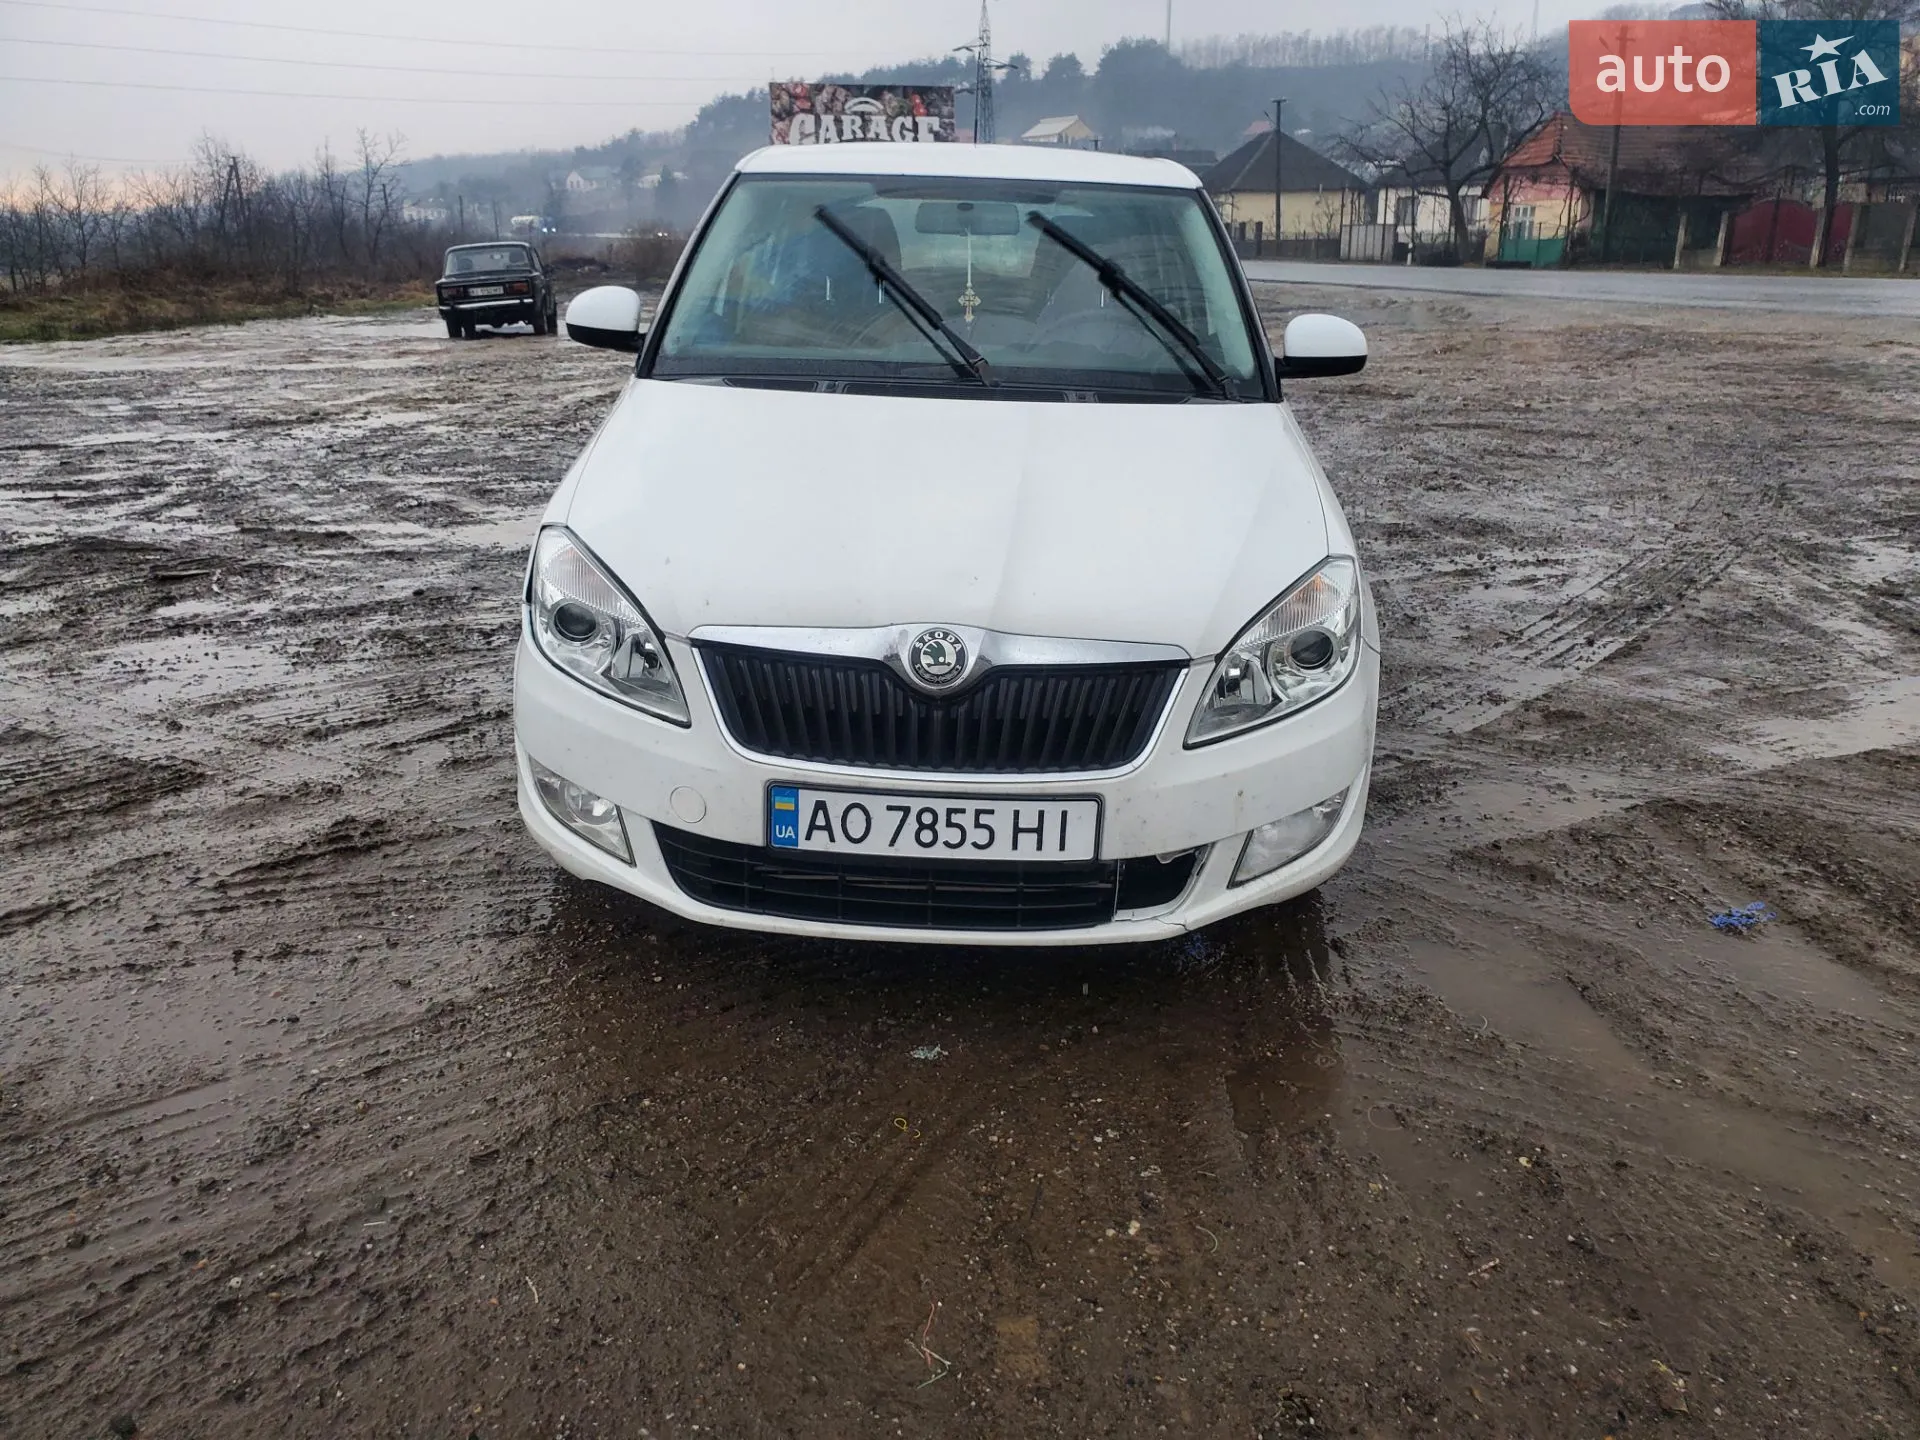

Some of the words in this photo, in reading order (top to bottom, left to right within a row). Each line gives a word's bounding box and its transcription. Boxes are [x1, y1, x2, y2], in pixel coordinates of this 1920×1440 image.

[789, 113, 941, 144] GARAGE
[775, 825, 796, 839] UA
[804, 799, 873, 844] AO
[885, 804, 996, 850] 7855
[1011, 809, 1069, 852] HI
